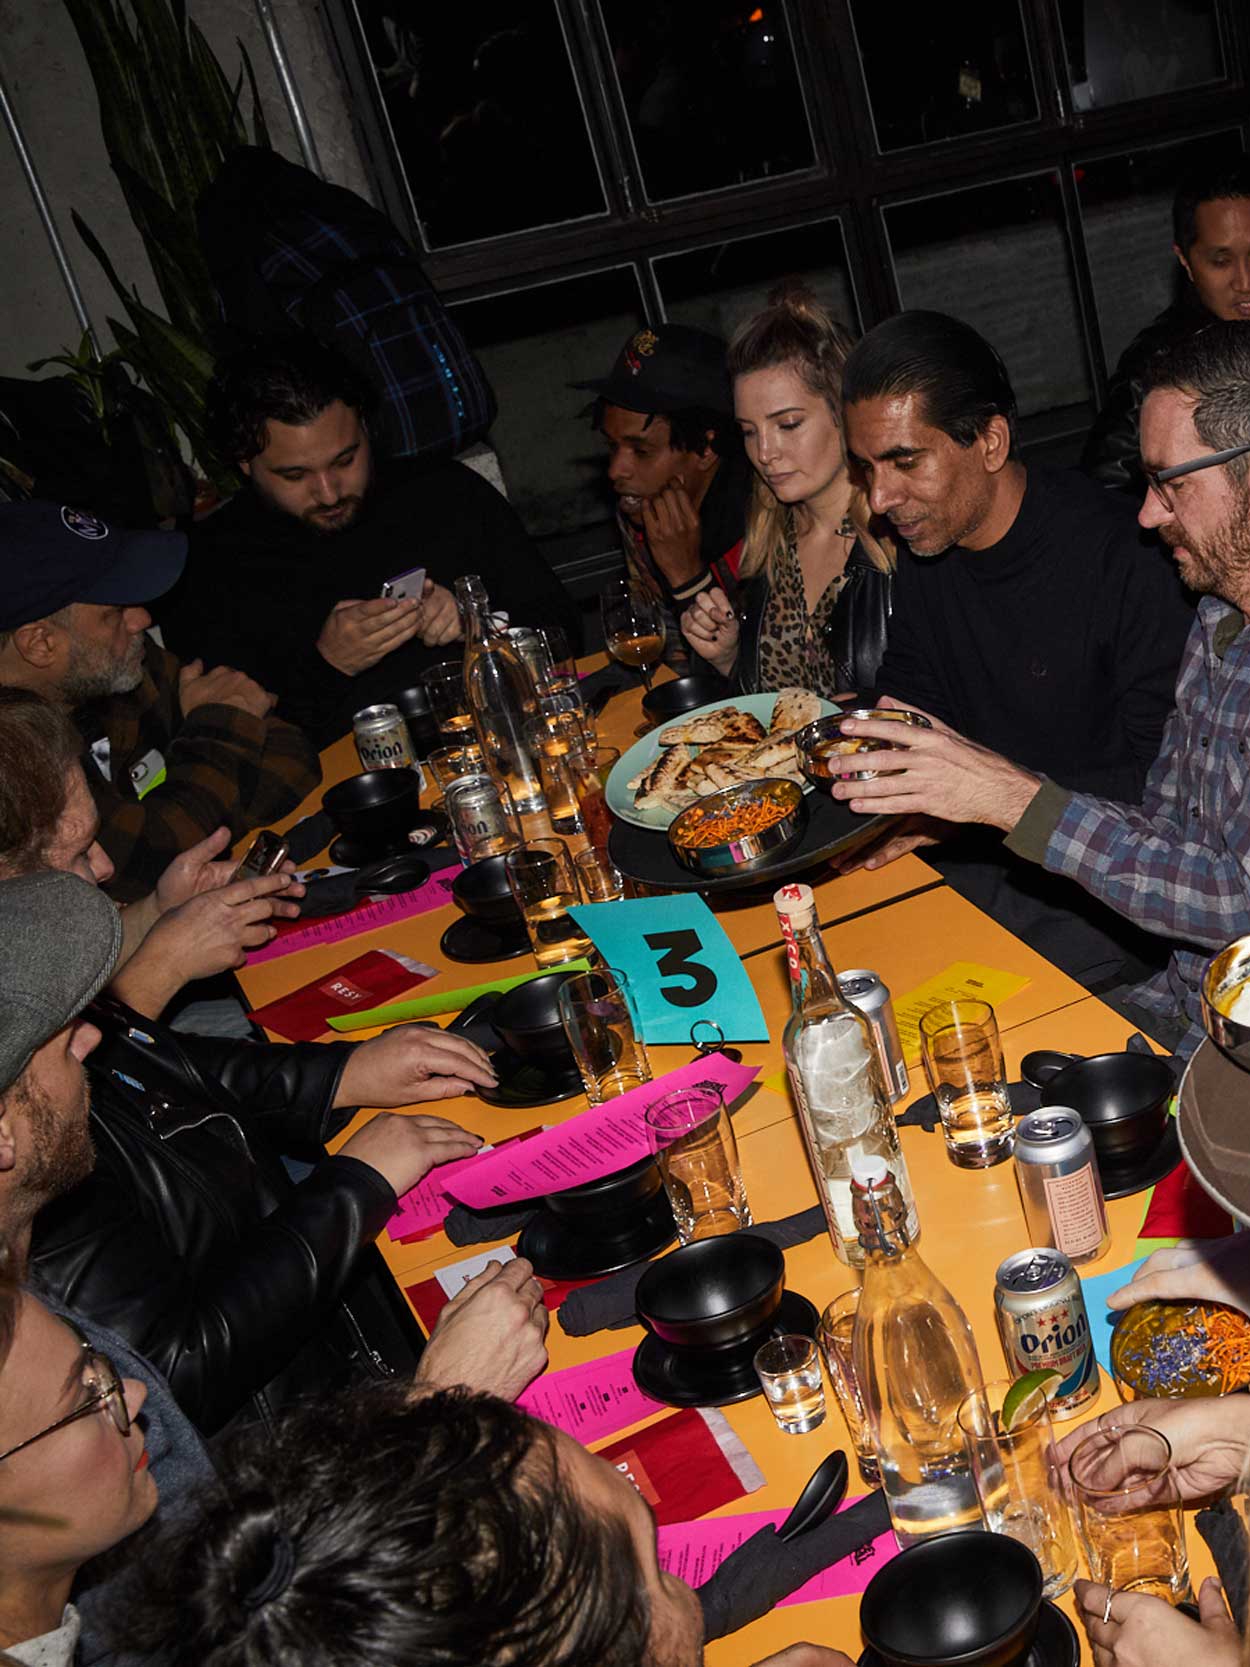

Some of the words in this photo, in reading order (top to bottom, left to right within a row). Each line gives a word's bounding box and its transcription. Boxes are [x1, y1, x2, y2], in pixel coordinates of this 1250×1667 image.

[642, 928, 719, 1008] 3
[330, 982, 363, 1000] RESY
[1020, 1312, 1087, 1354] Orion
